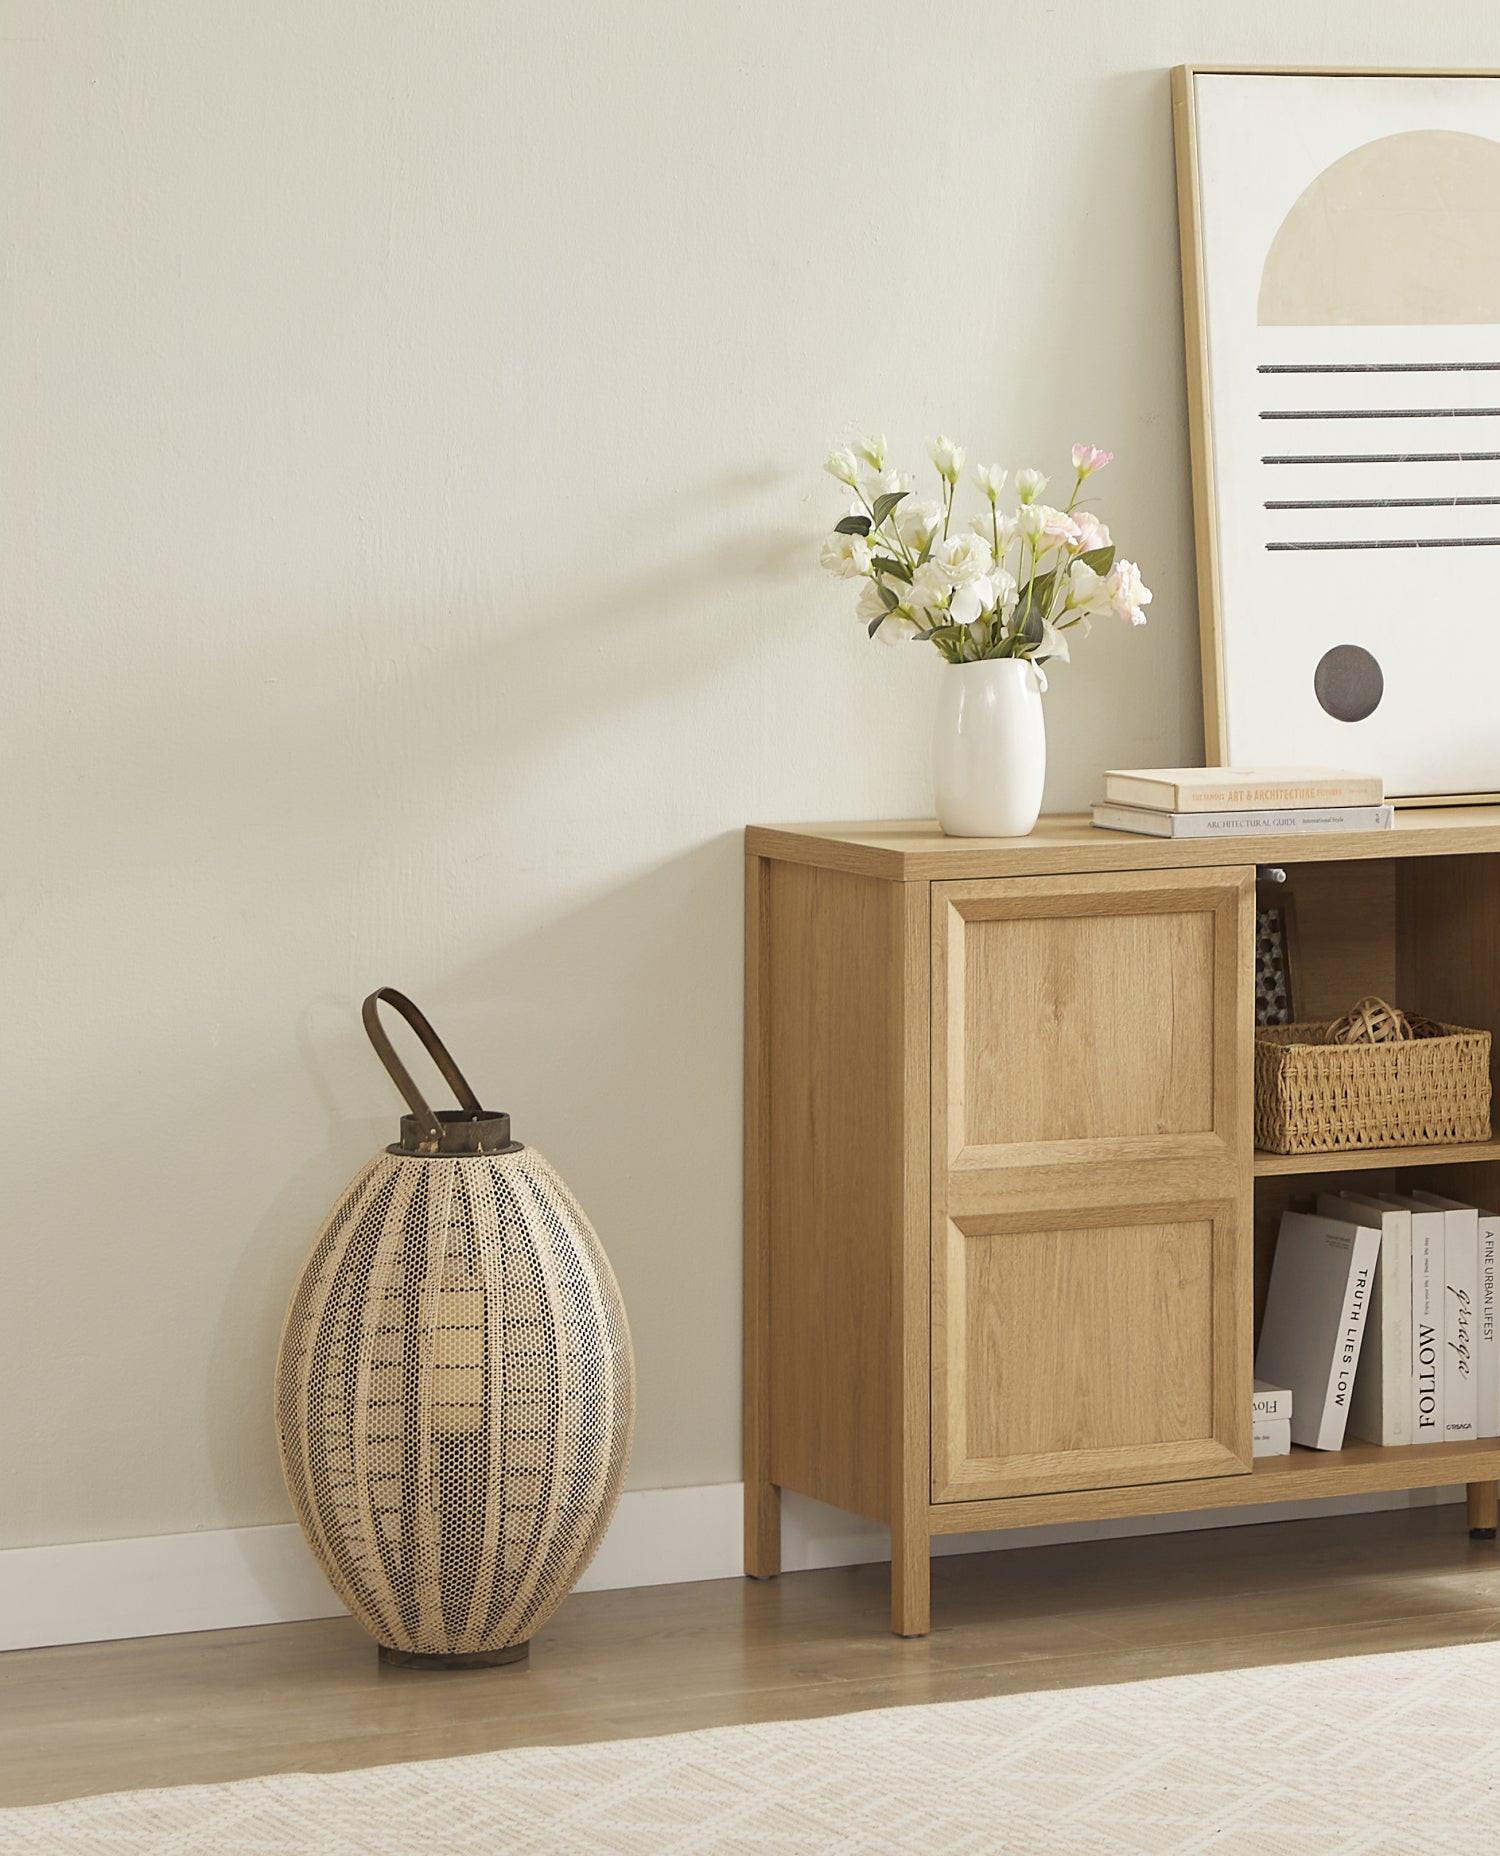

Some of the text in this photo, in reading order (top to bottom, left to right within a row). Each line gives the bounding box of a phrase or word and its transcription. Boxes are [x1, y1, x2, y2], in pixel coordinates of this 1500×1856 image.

[1207, 817, 1272, 829] ARCHITECTURAL
[1272, 817, 1297, 827] GUIDE
[1302, 816, 1332, 824] International
[1228, 789, 1244, 802] ART
[1246, 789, 1253, 801] &
[1254, 786, 1316, 801] ARCHITECTURE
[1334, 1268, 1369, 1407] TRUTH LIES LOW
[1483, 1230, 1495, 1342] A FINE URBAN LIFEST
[1419, 1324, 1436, 1429] FOLLOW
